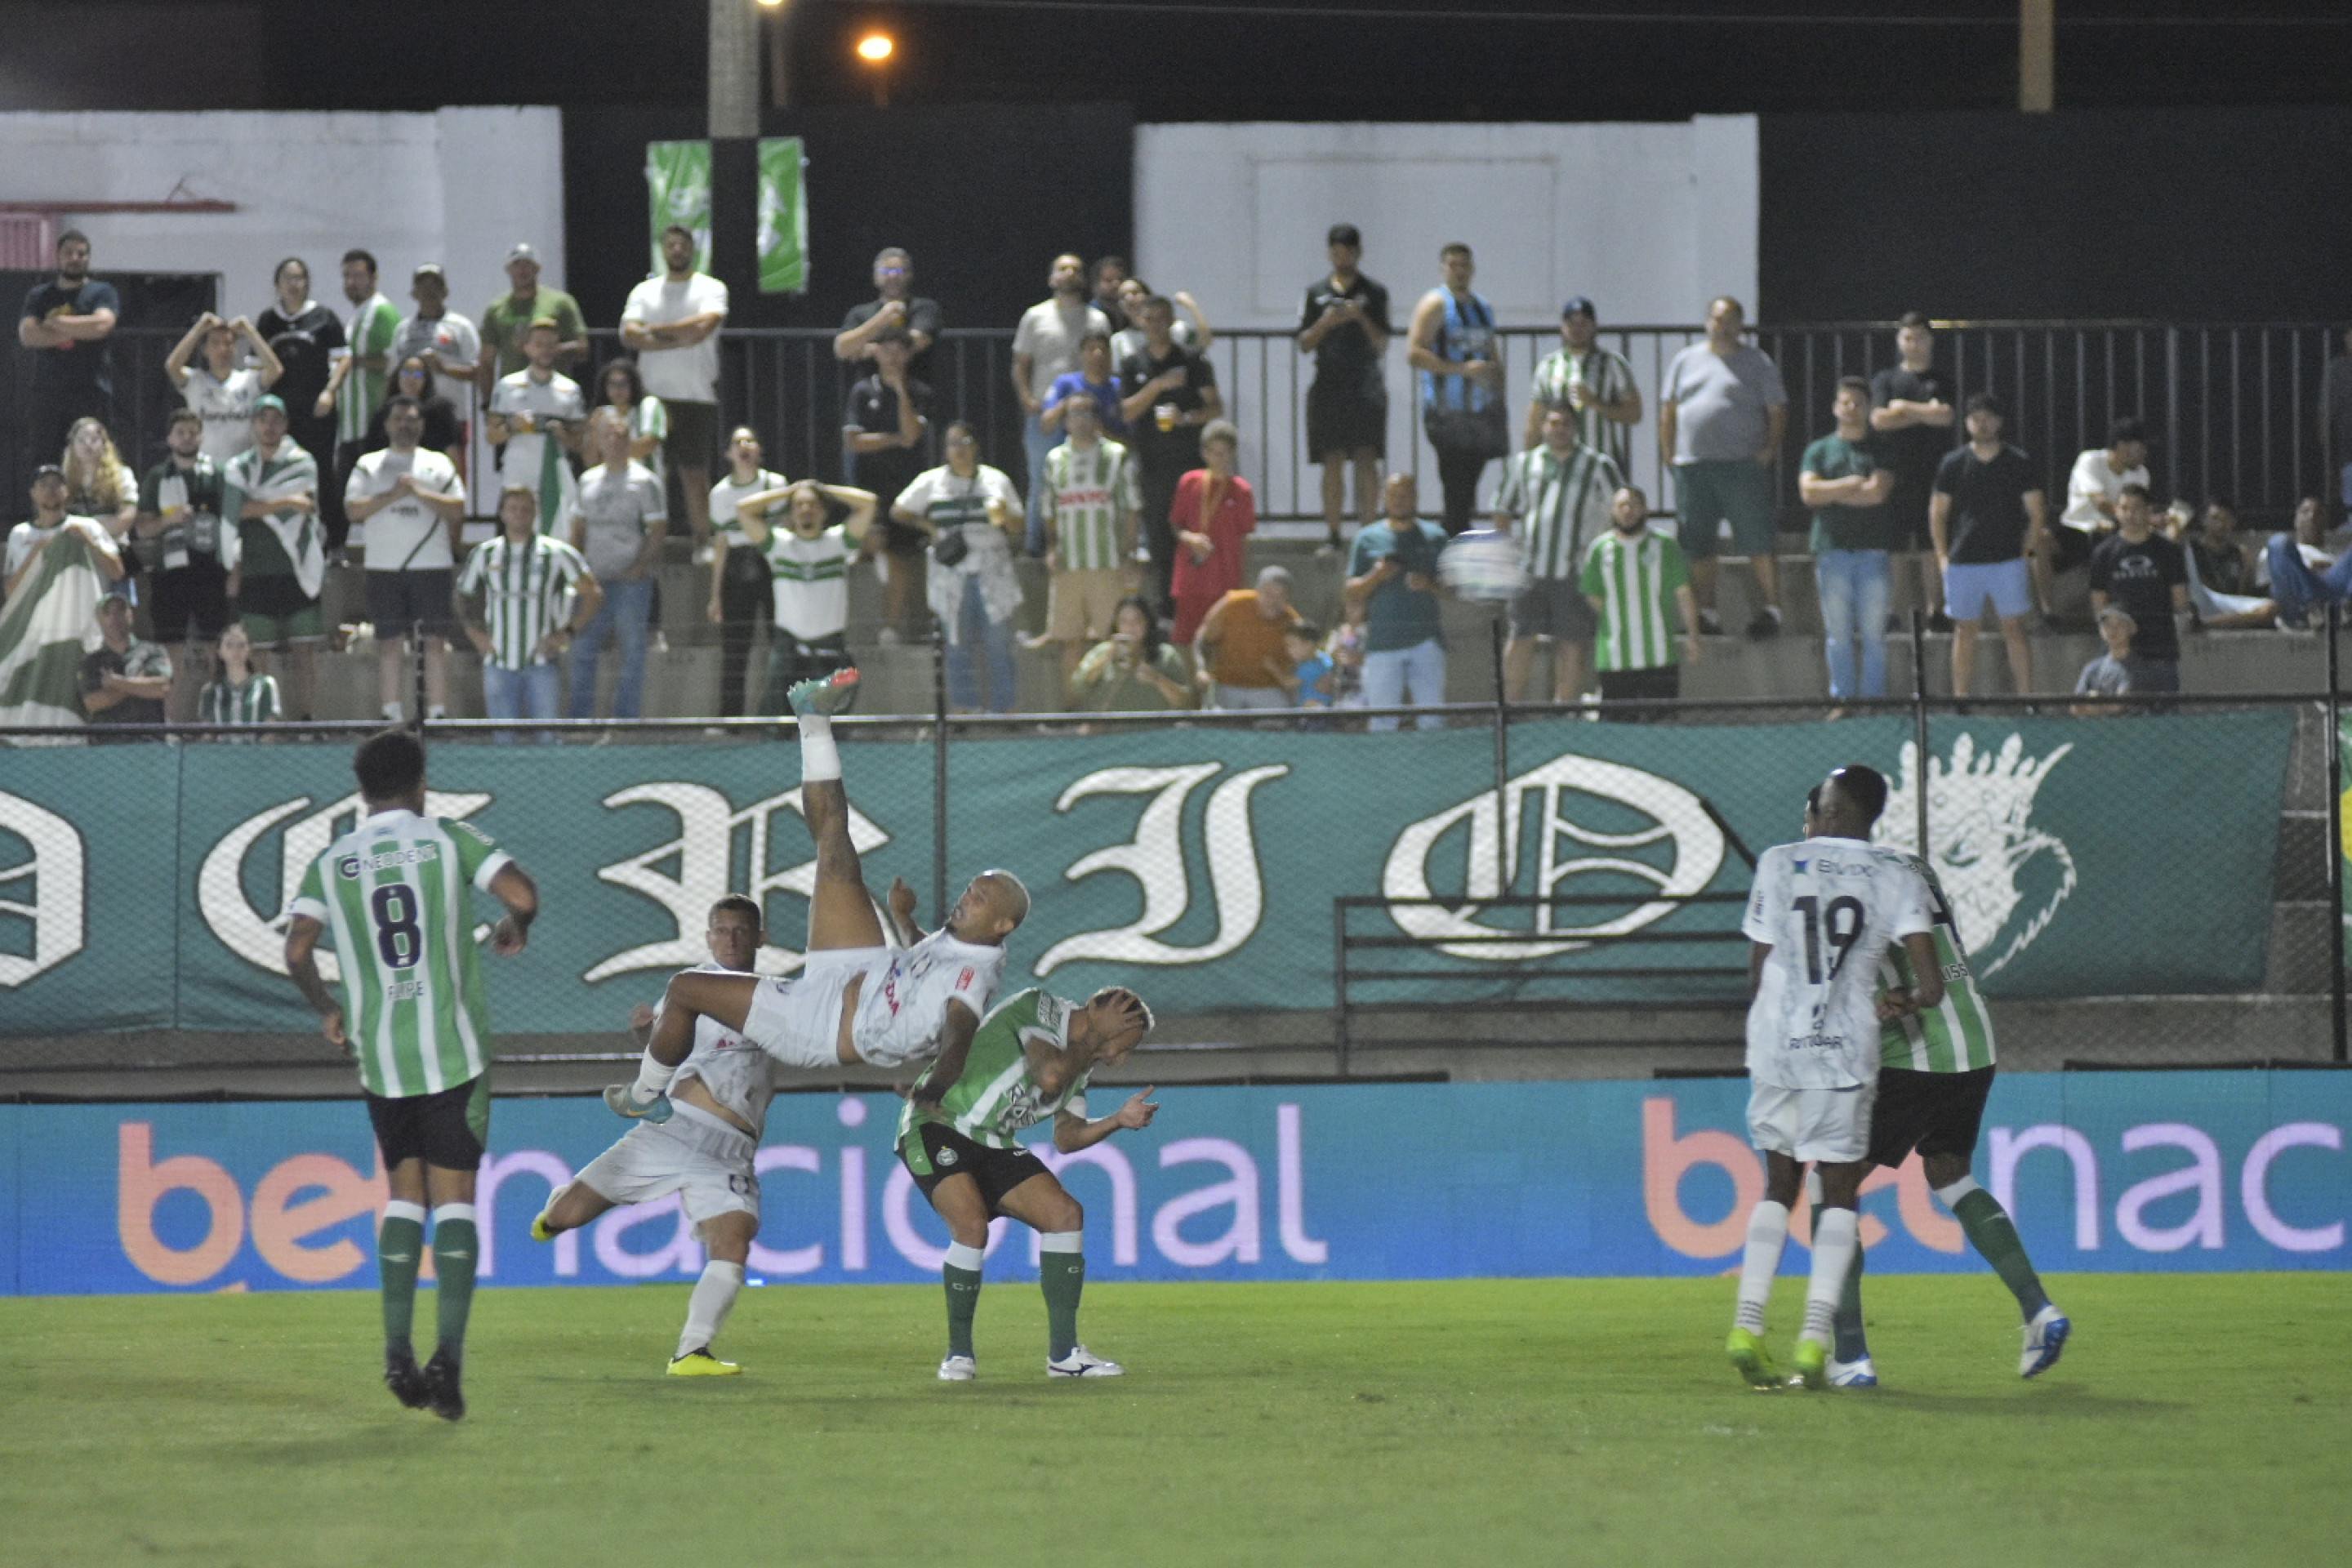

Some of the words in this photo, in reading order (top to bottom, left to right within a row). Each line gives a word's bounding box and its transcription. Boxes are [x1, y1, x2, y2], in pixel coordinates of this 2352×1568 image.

[372, 884, 422, 969] 8
[1791, 896, 1865, 985] 19
[118, 1102, 1329, 1285] benacional
